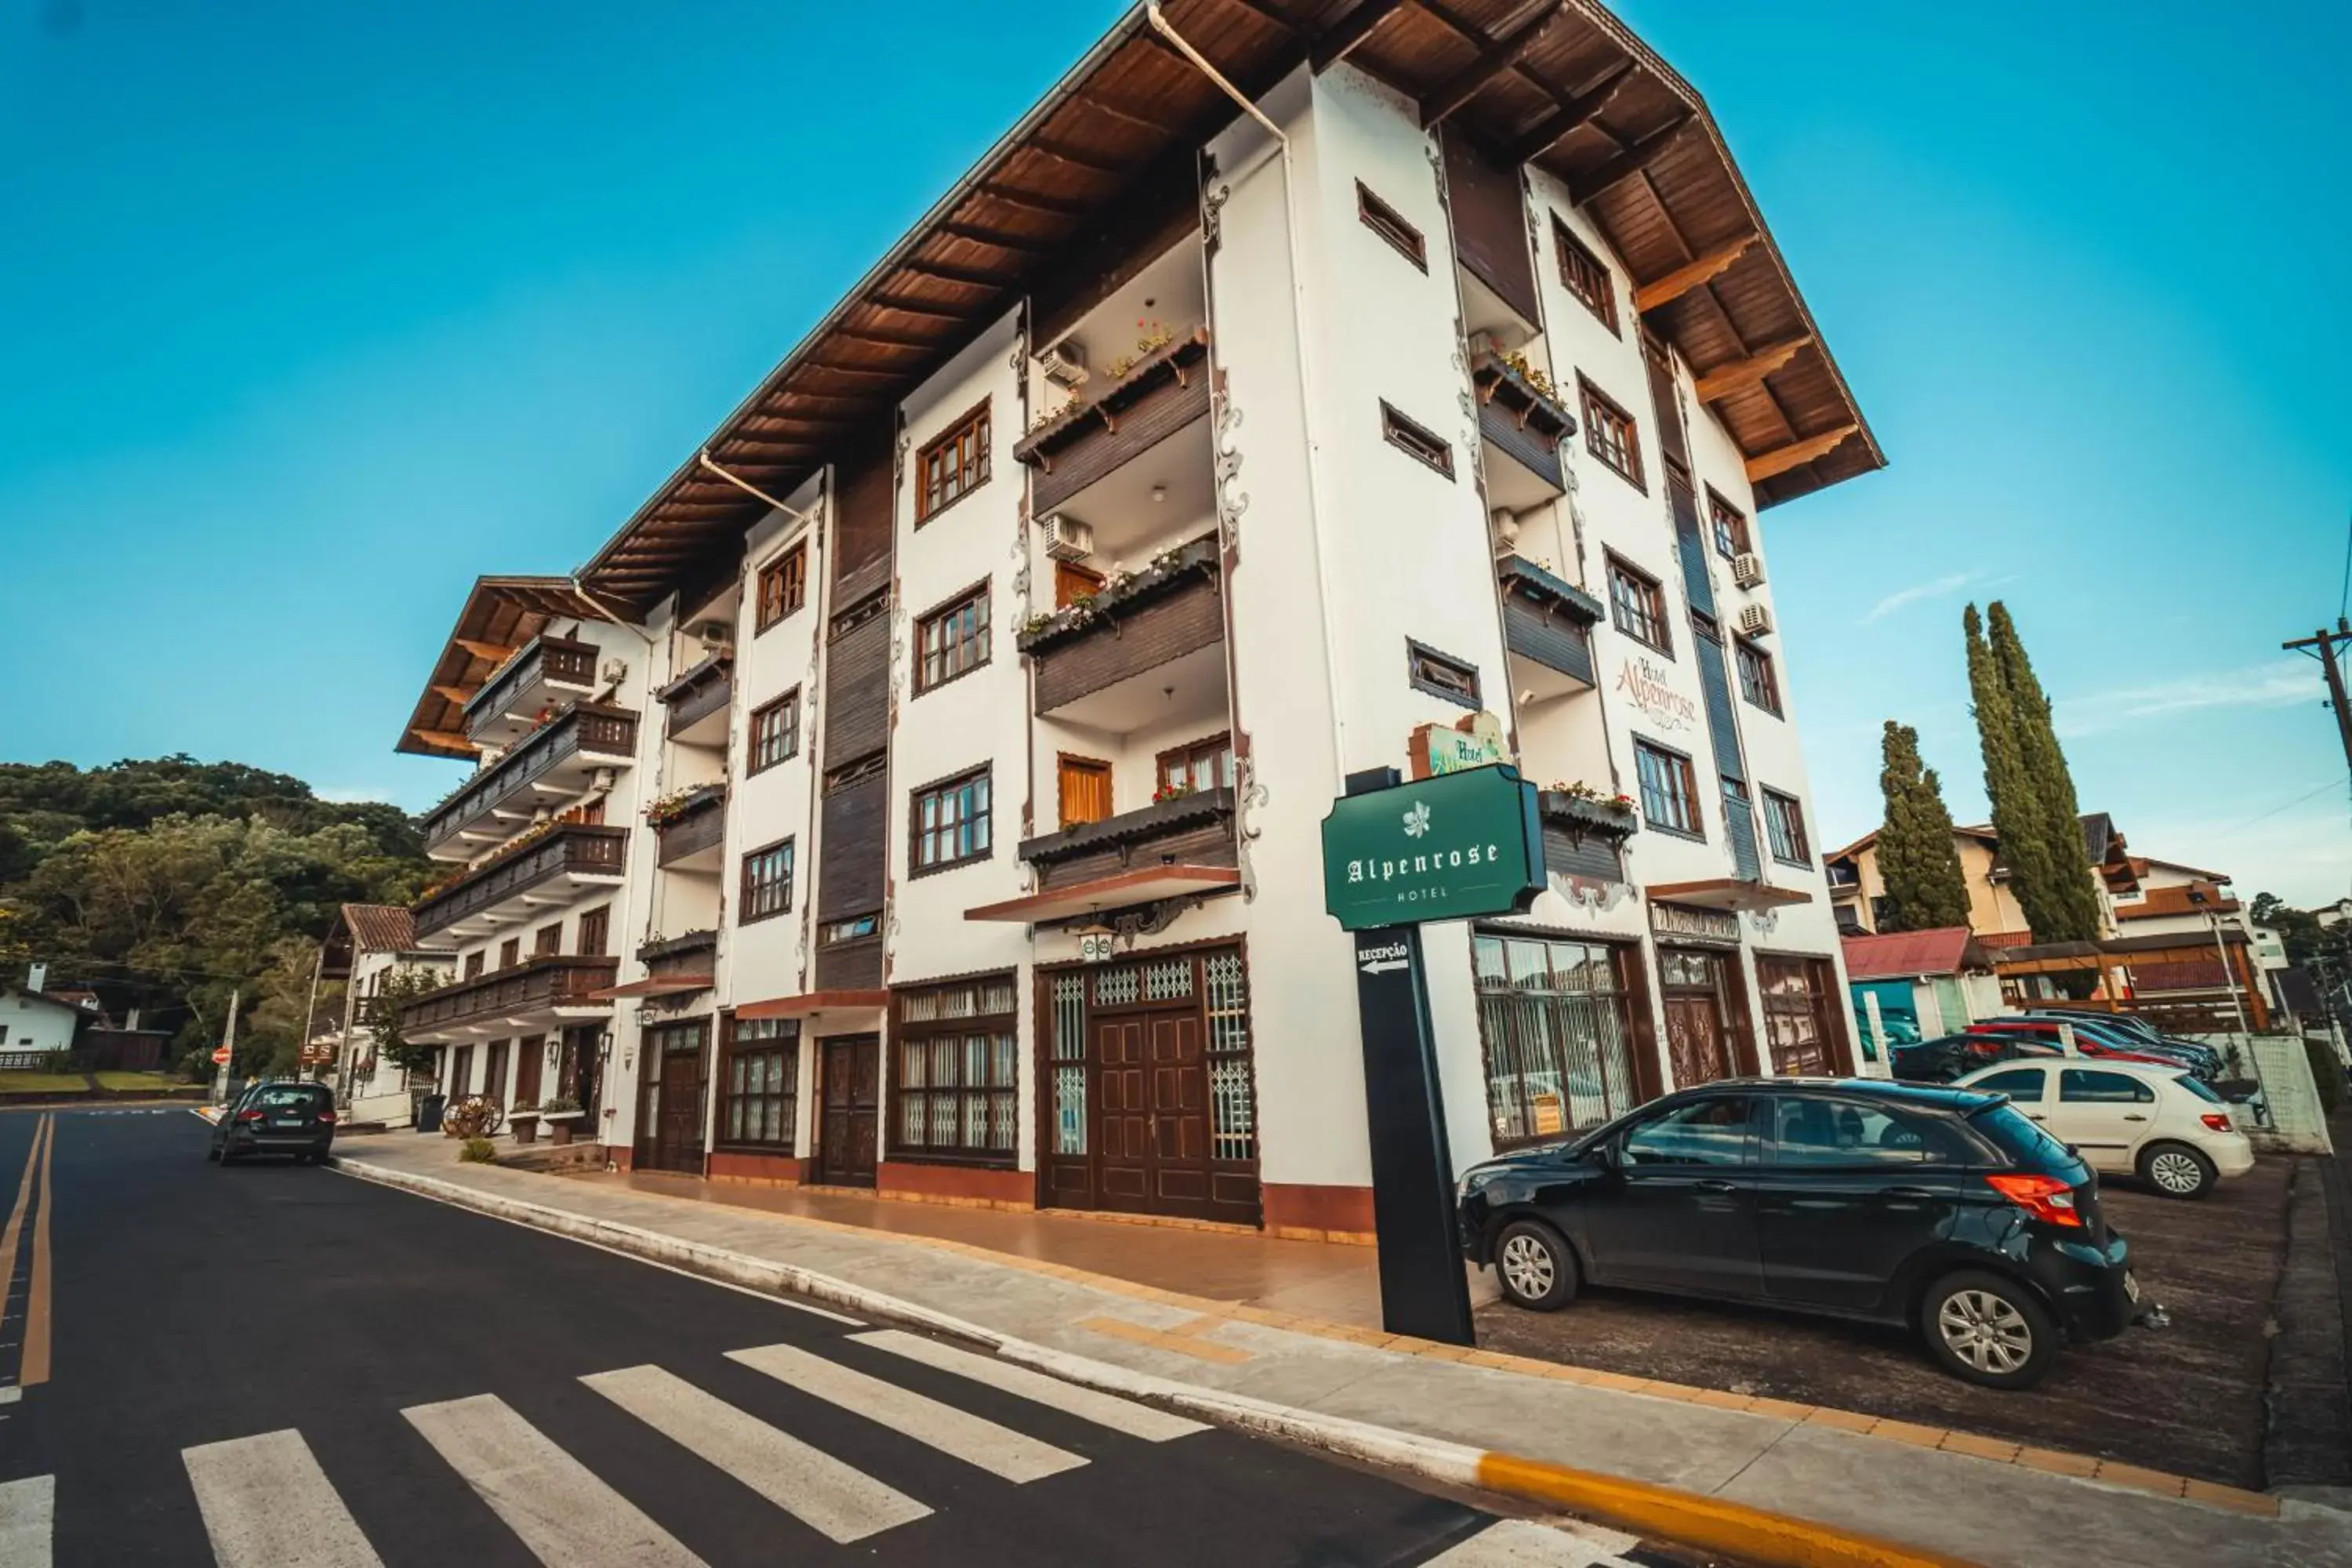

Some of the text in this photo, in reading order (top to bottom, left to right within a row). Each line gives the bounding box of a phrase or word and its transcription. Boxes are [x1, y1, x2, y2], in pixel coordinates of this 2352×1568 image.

[1456, 739, 1483, 763] Hotel
[1348, 844, 1498, 884] Alpenrose
[1398, 887, 1448, 902] HOTEL
[1358, 942, 1407, 962] RECEPÇÃO
